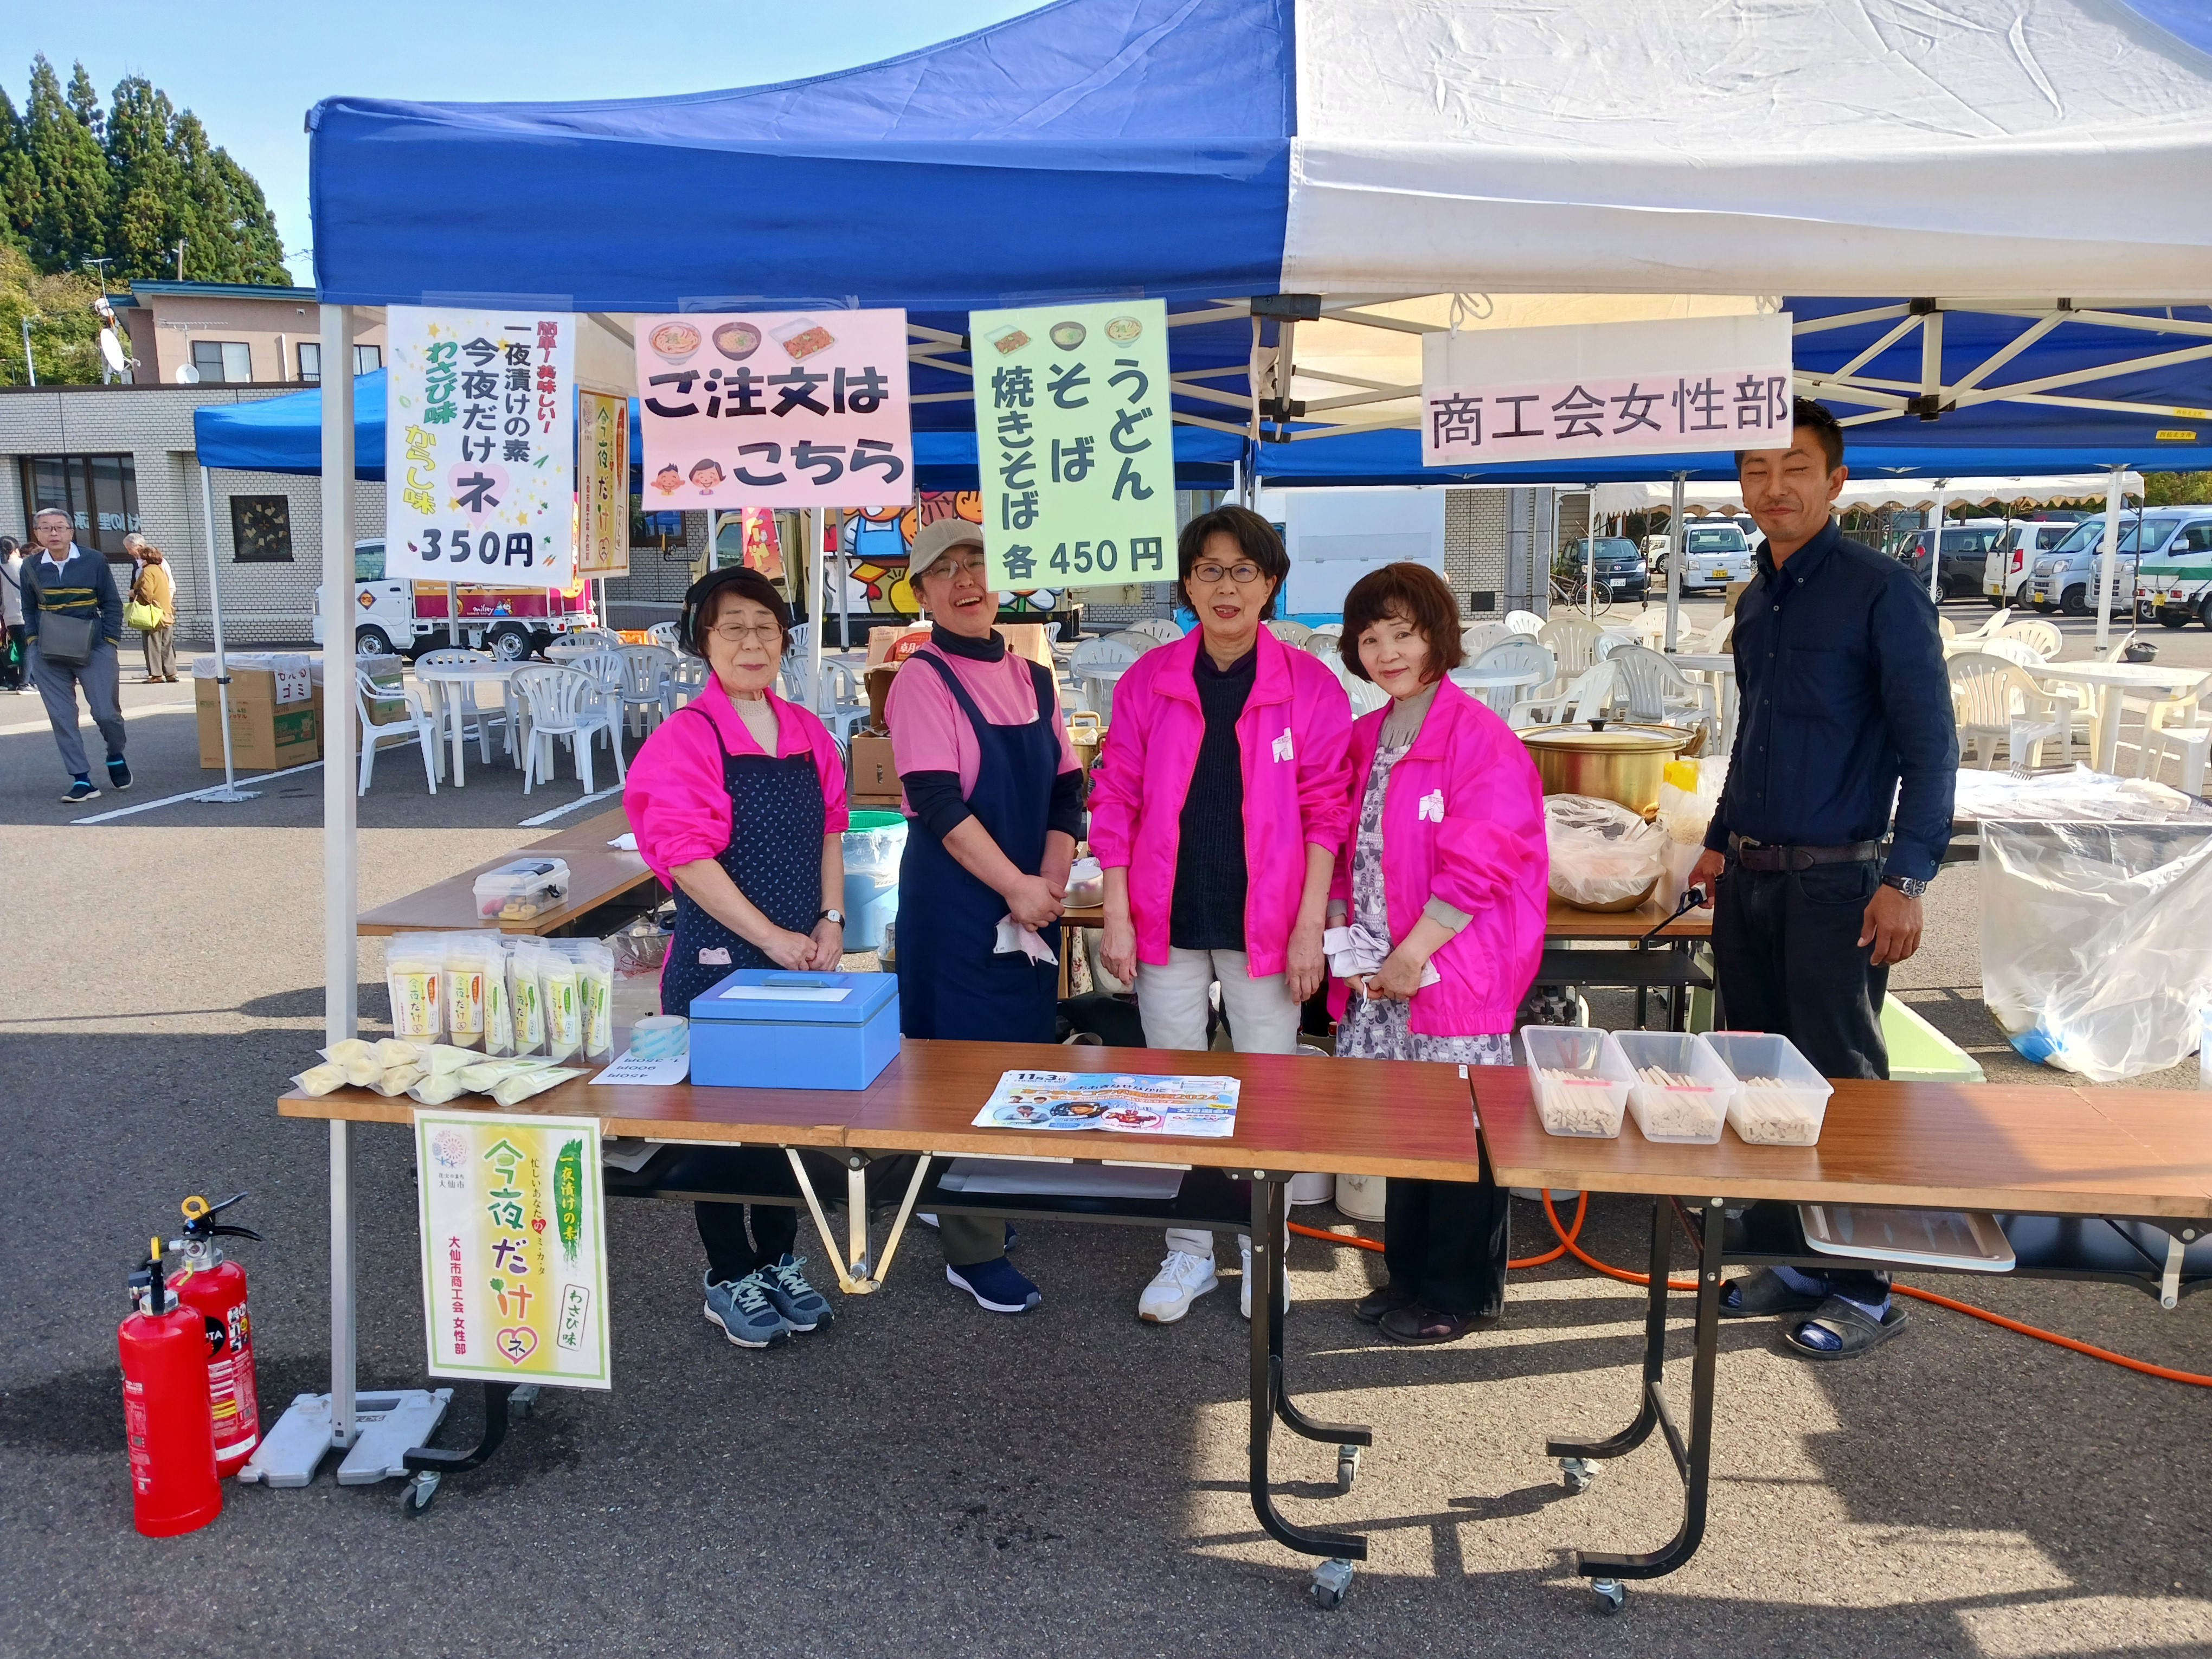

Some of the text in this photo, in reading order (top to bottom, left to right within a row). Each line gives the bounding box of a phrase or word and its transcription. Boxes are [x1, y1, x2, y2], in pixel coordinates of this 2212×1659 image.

[423, 342, 458, 424] わさび味
[503, 326, 532, 462] 一夜漬けの素
[645, 366, 889, 419] ご注文は
[1047, 362, 1095, 483] そば
[1429, 374, 1788, 449] 商工会女性部
[403, 425, 436, 515] からし味
[733, 438, 904, 486] こちら
[991, 365, 1039, 531] 焼きそば
[1107, 358, 1154, 501] うどん
[421, 529, 533, 567] 350円
[282, 683, 304, 698] ゴミ
[439, 1179, 464, 1188] 大仙市
[560, 1156, 577, 1240] 一夜漬けの素
[448, 1236, 466, 1355] 大仙市商工会 女性部
[562, 1289, 583, 1347] わさび味
